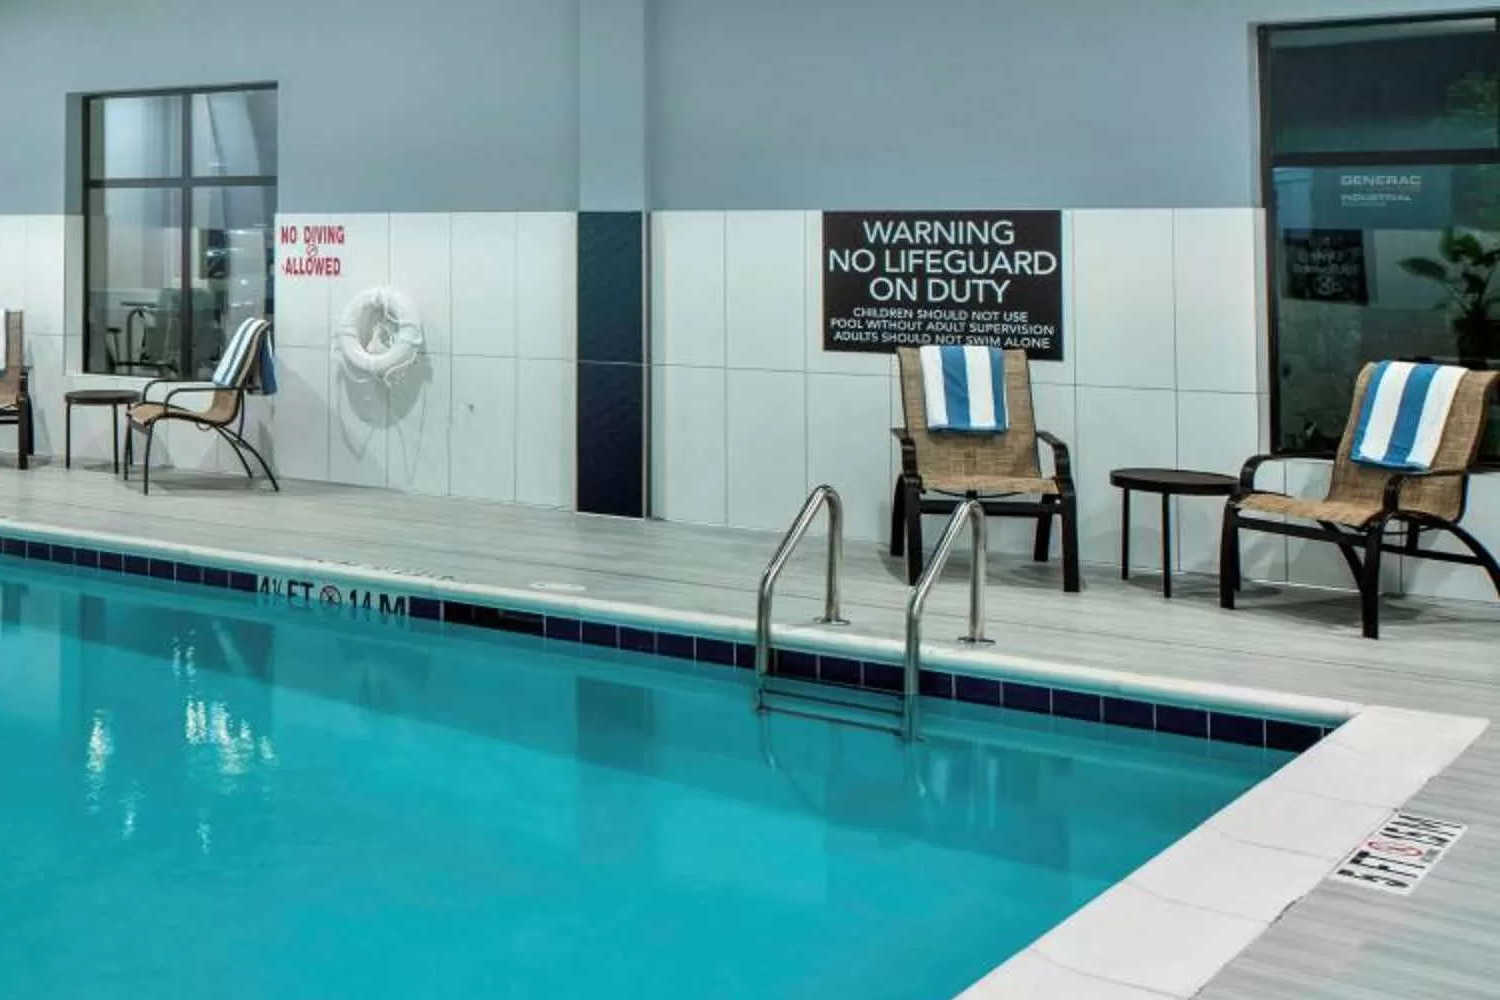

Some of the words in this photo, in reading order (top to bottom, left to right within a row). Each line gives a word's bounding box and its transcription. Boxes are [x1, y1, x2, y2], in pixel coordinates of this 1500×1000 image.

[281, 226, 297, 244] NO
[303, 225, 345, 244] DIVING
[862, 220, 1015, 245] WARNING
[285, 257, 341, 276] ALLOWED
[829, 249, 876, 273] NO
[885, 249, 1057, 276] LIFEGUARD
[869, 277, 917, 301] ON
[927, 278, 1011, 304] DUTY
[853, 306, 913, 319] CHILDREN
[917, 308, 968, 321] SHOULD
[971, 311, 1000, 322] NOT
[1003, 312, 1028, 323] USE
[831, 318, 863, 330] POOL
[867, 319, 922, 331] WITHOUT
[926, 321, 966, 333] ADULT
[969, 322, 1054, 336] SUPERVISION
[833, 331, 878, 342] ADULTS
[882, 332, 931, 345] SHOULD
[935, 335, 962, 346] NOT
[966, 335, 1000, 347] SWIM
[1003, 336, 1051, 349] ALONE
